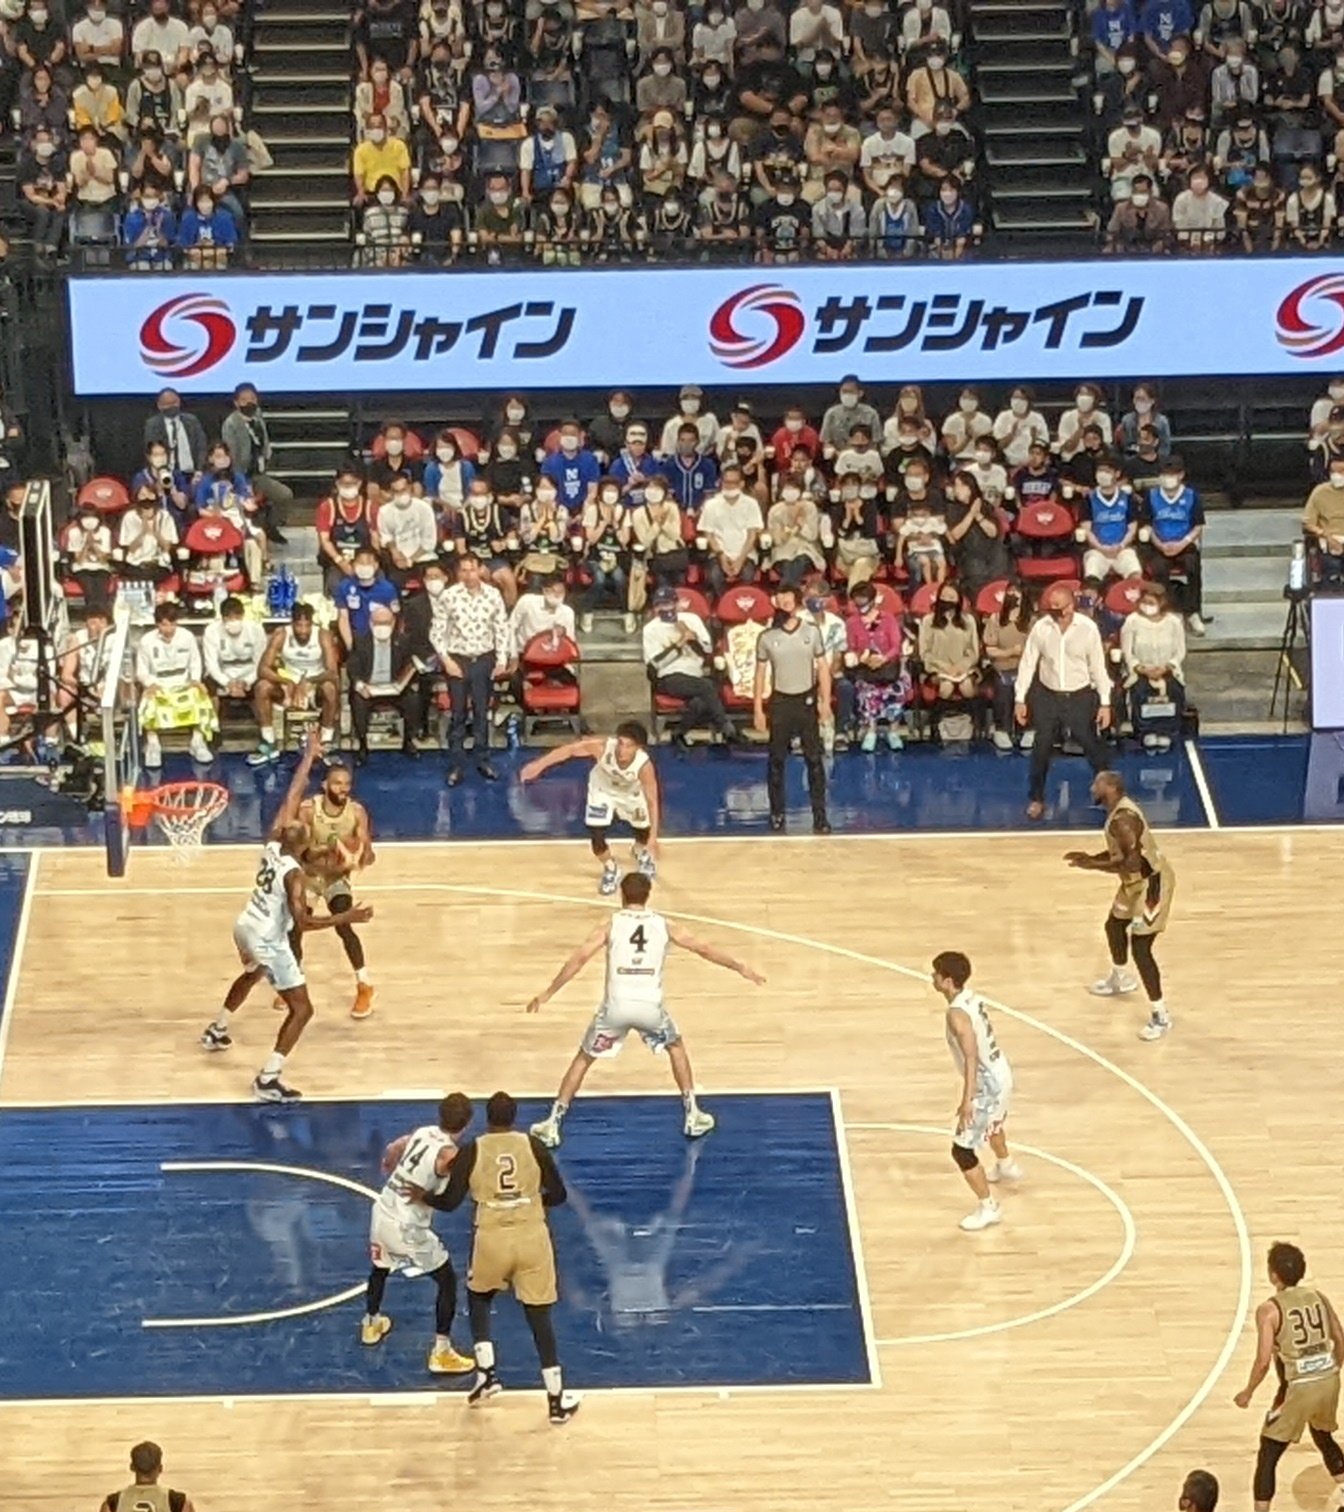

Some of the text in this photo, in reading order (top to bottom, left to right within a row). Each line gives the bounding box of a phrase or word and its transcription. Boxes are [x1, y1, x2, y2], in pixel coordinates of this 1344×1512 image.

[245, 300, 577, 363] サンシャイン
[813, 290, 1146, 354] サンシャイン
[629, 924, 648, 953] 4
[400, 1138, 430, 1173] 14
[498, 1155, 516, 1191] 2
[1287, 1303, 1327, 1345] 34
